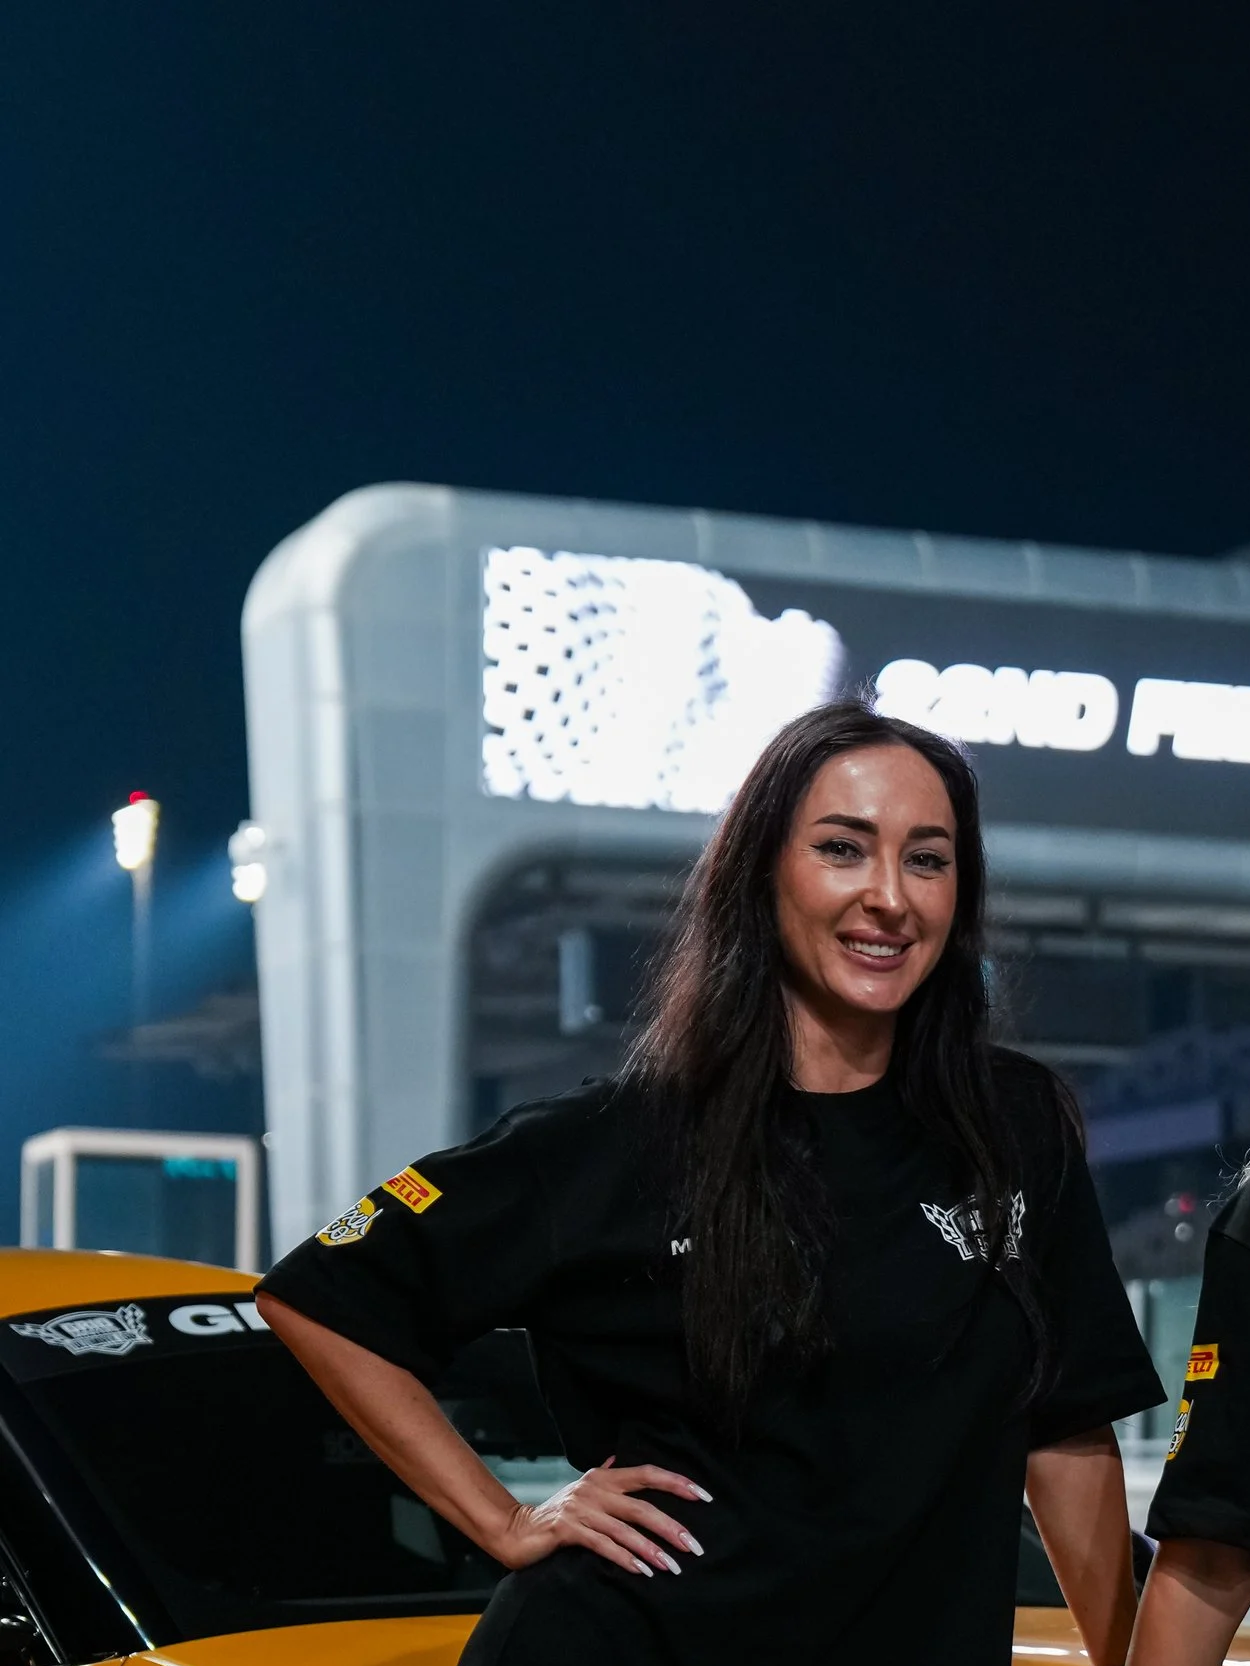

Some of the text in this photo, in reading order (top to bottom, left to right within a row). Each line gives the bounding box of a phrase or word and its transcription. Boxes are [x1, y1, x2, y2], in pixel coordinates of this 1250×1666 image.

[876, 659, 1118, 752] 22ND
[386, 1177, 422, 1207] ELLI
[1187, 1361, 1213, 1374] ELLI
